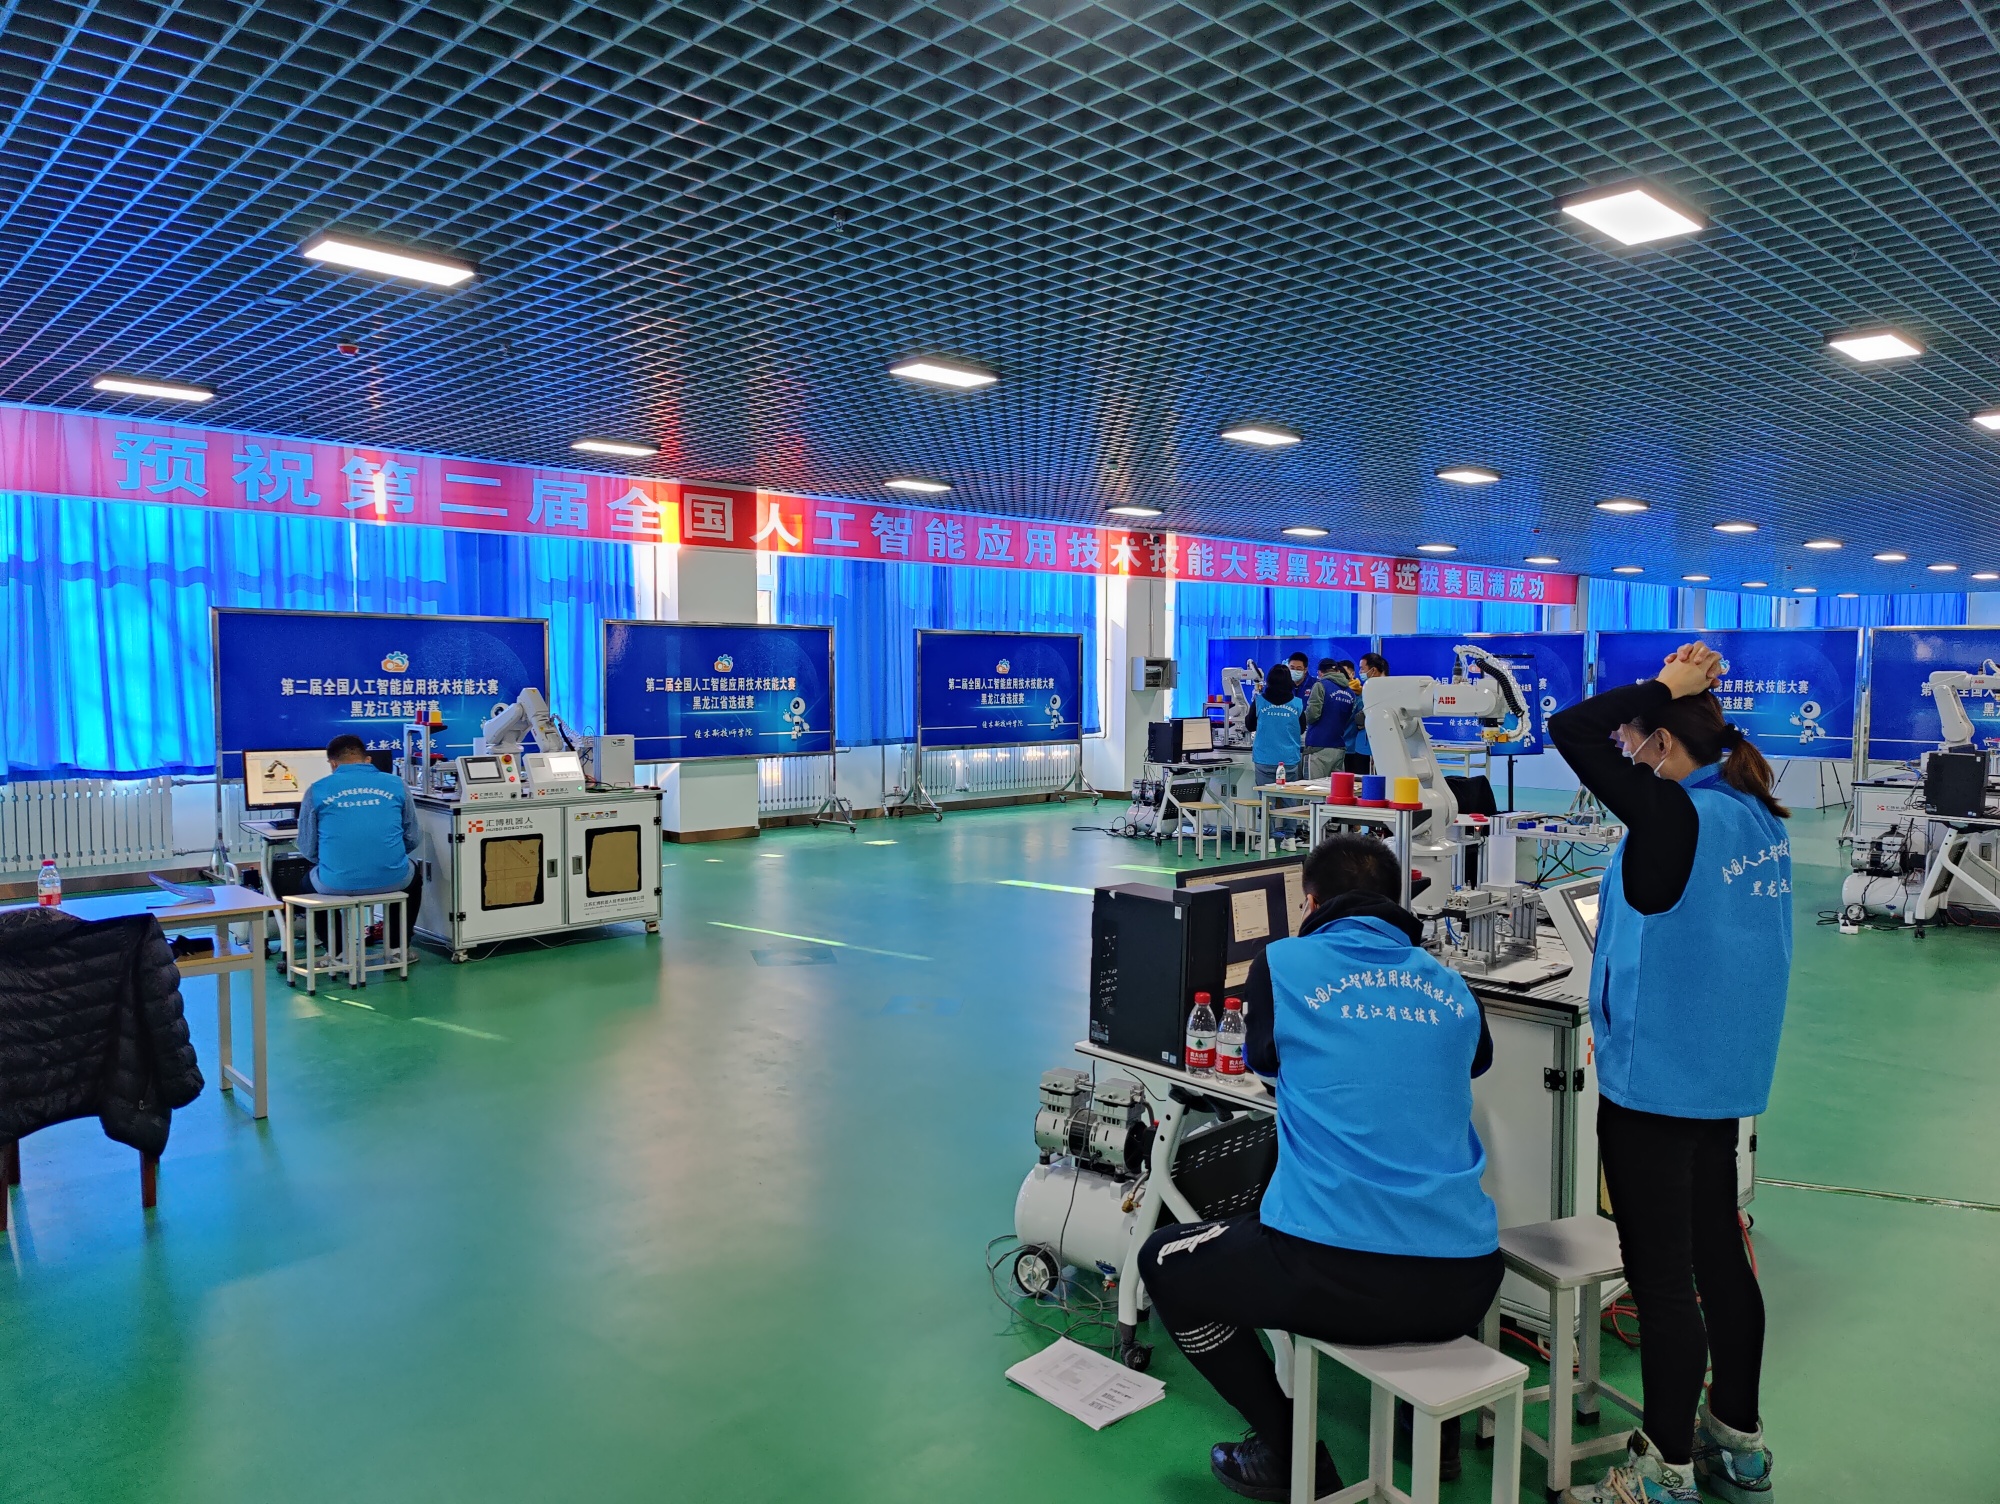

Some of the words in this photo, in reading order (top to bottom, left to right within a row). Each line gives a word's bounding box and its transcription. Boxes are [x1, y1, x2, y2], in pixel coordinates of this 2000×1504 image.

[281, 677, 499, 696] 第二届全国人工智能应用技术技能大赛
[645, 677, 797, 692] 第二届全国人工智能应用技术技能大赛
[1709, 679, 1809, 694] 能应用技术技能大赛
[692, 695, 755, 710] 黑龙江省选拔赛
[1304, 968, 1465, 1019] 全国人工智能应用技术技能大赛
